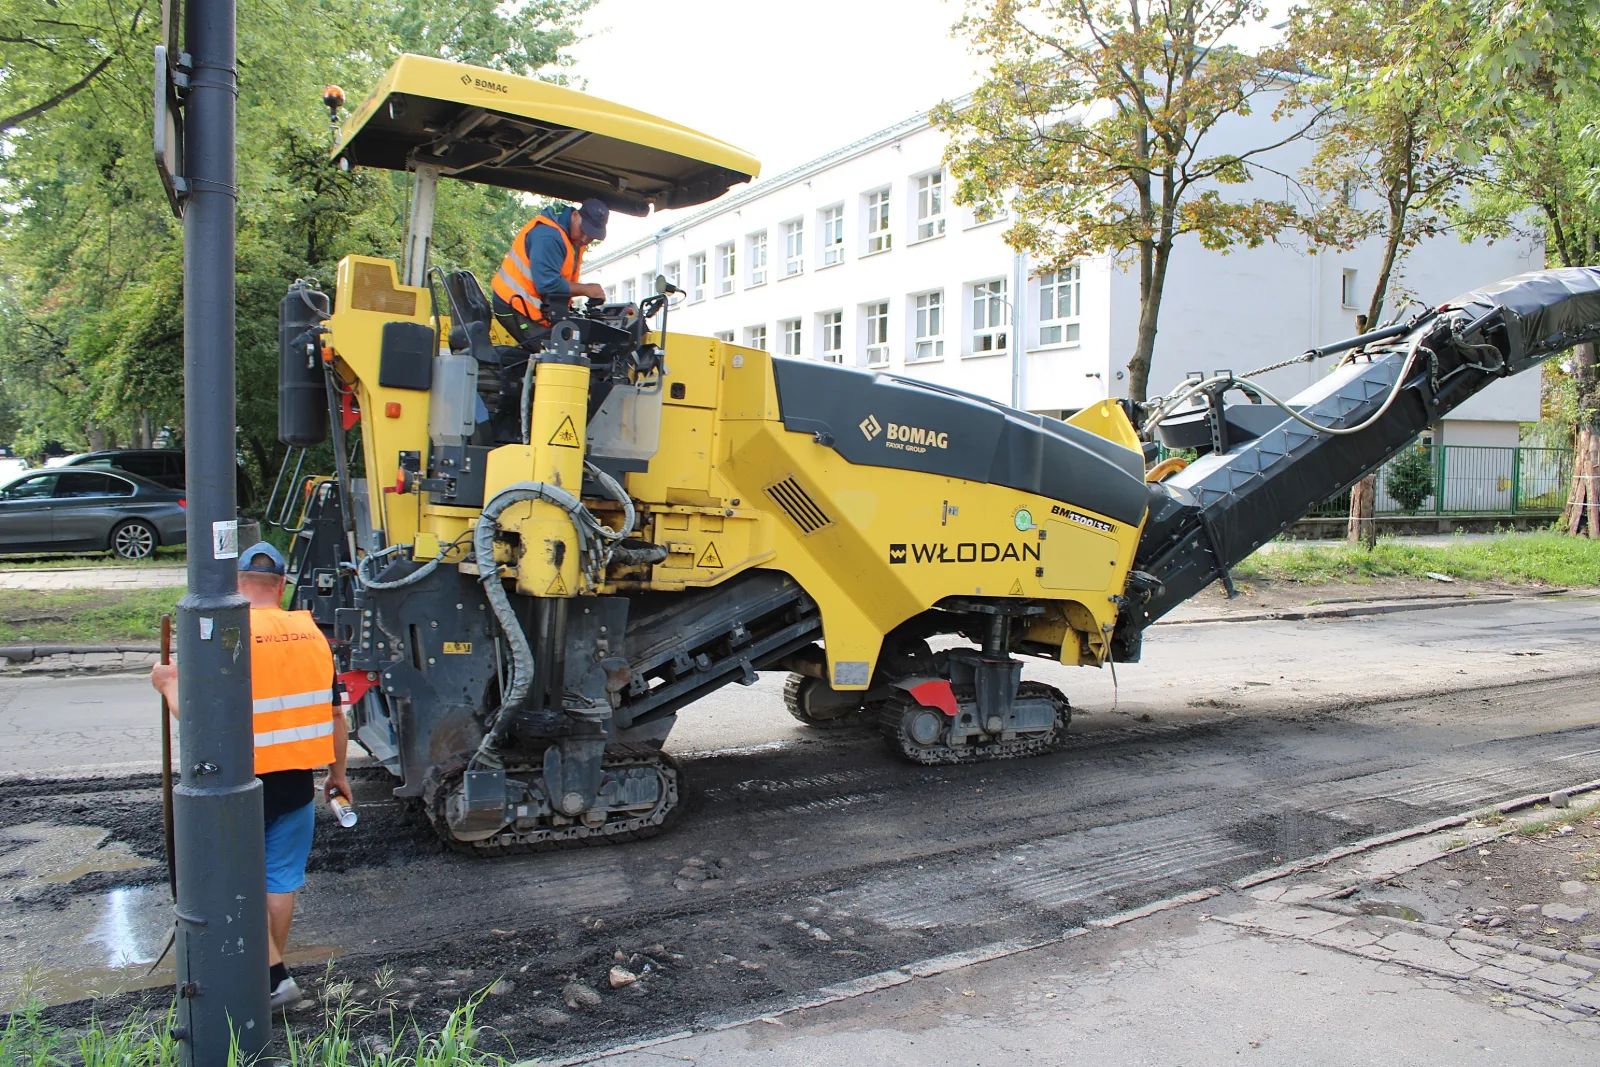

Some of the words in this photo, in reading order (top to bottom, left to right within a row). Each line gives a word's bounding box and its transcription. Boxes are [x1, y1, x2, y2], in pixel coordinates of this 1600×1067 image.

[475, 79, 508, 93] BOMAG
[887, 423, 948, 449] BOMAG
[886, 441, 904, 450] FAYAT
[905, 444, 926, 453] GROUP
[911, 543, 1041, 563] WŁODAN
